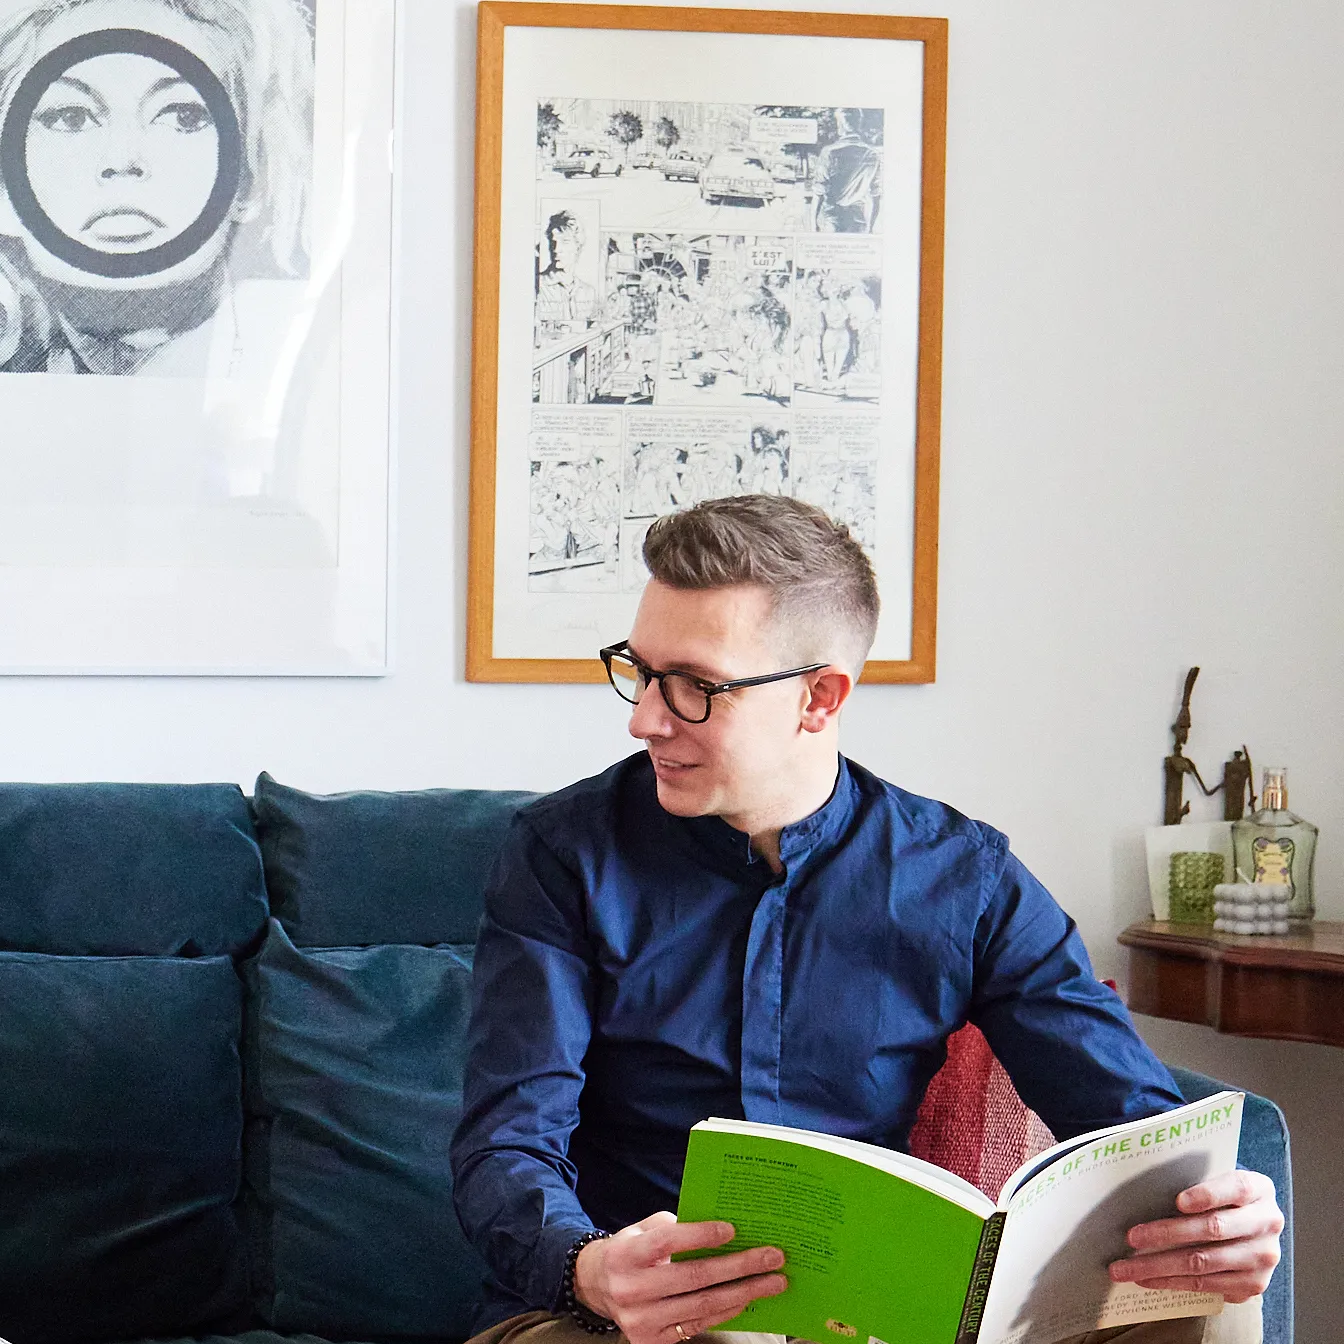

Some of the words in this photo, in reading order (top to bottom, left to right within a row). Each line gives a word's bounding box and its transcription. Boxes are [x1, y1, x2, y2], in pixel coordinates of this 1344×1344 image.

[1062, 1154, 1086, 1175] OF
[1092, 1137, 1132, 1161] THE
[1140, 1103, 1235, 1148] CENTURY
[984, 1217, 1003, 1250] FACES
[975, 1266, 992, 1289] THE
[965, 1289, 988, 1334] CENTURY
